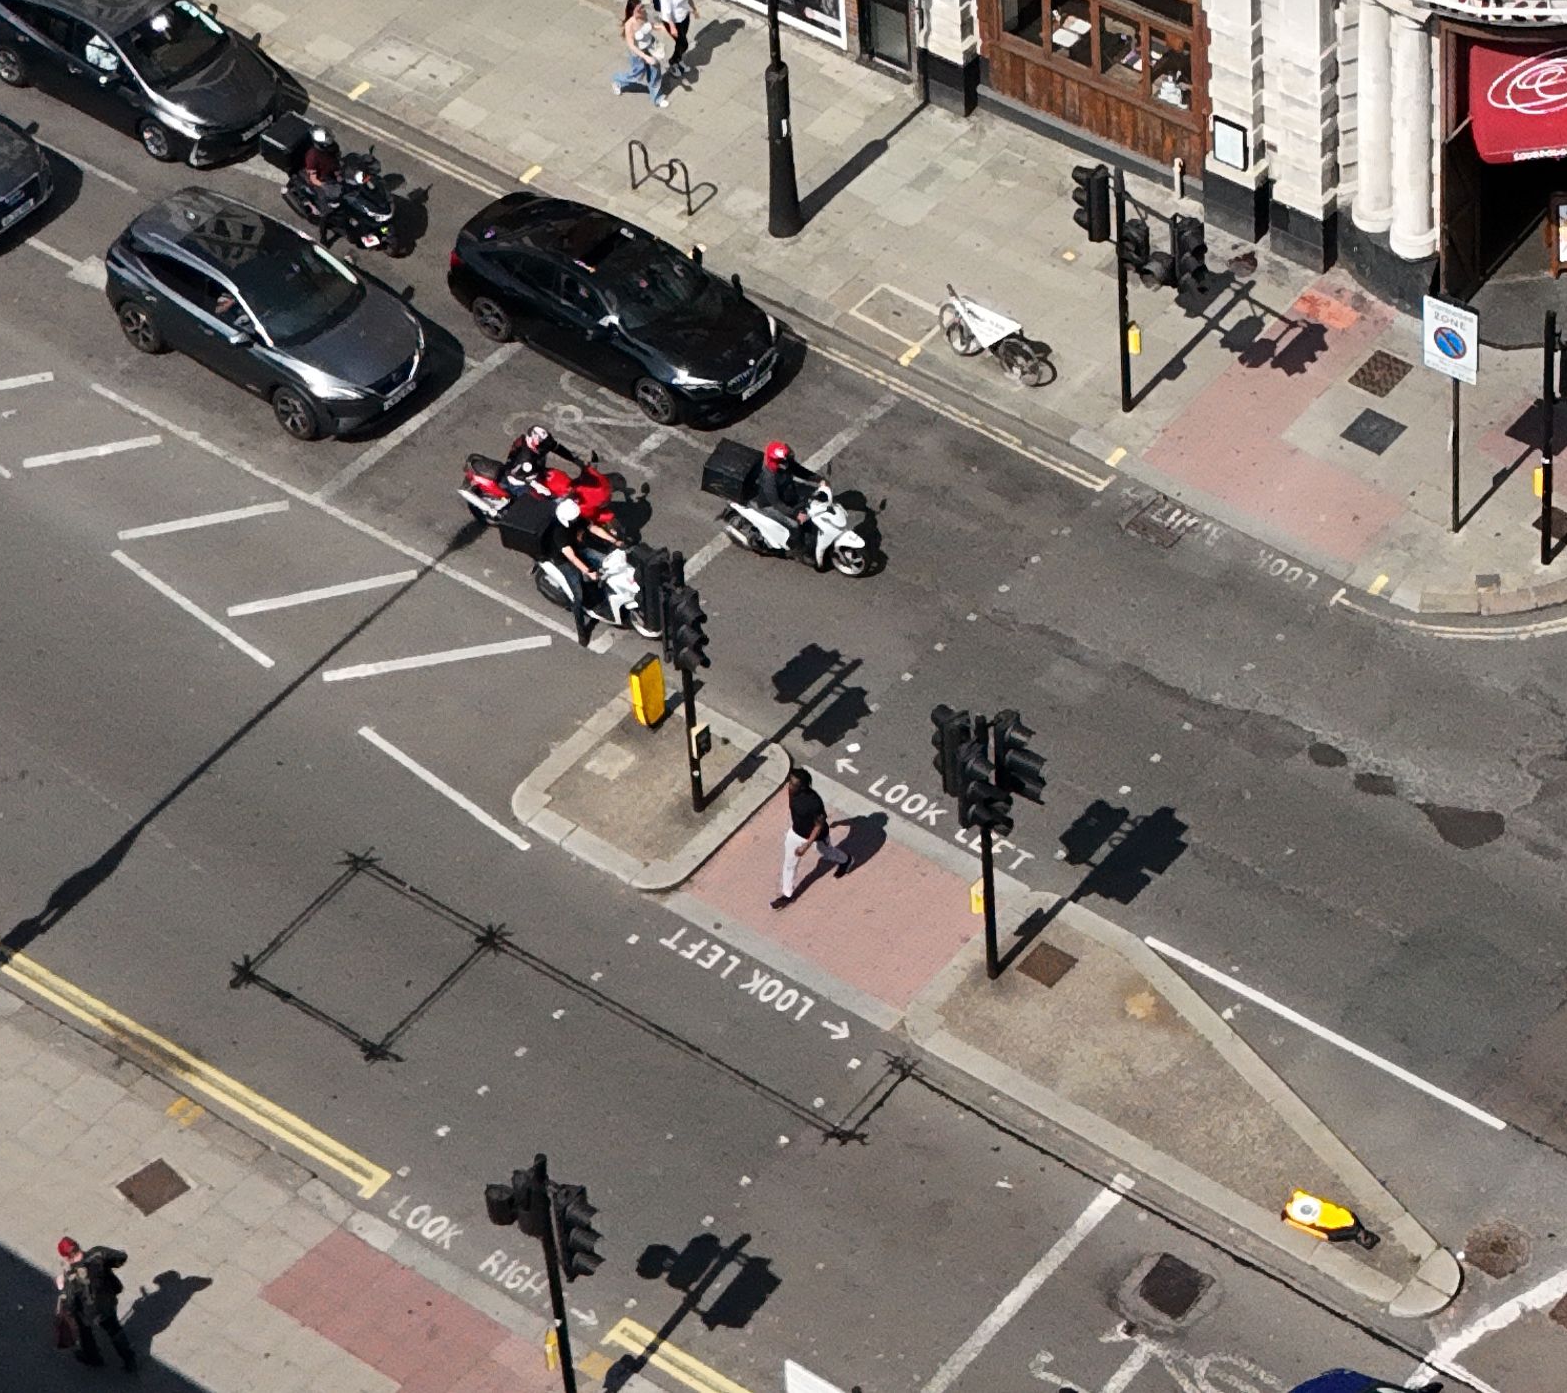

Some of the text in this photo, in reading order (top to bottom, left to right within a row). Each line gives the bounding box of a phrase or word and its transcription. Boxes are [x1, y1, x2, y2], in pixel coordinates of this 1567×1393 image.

[1434, 311, 1466, 331] ZONE
[867, 774, 1036, 871] LOOK LEFT
[659, 926, 815, 1023] LOOK LEFT
[387, 1195, 569, 1309] LOOK RIGH
